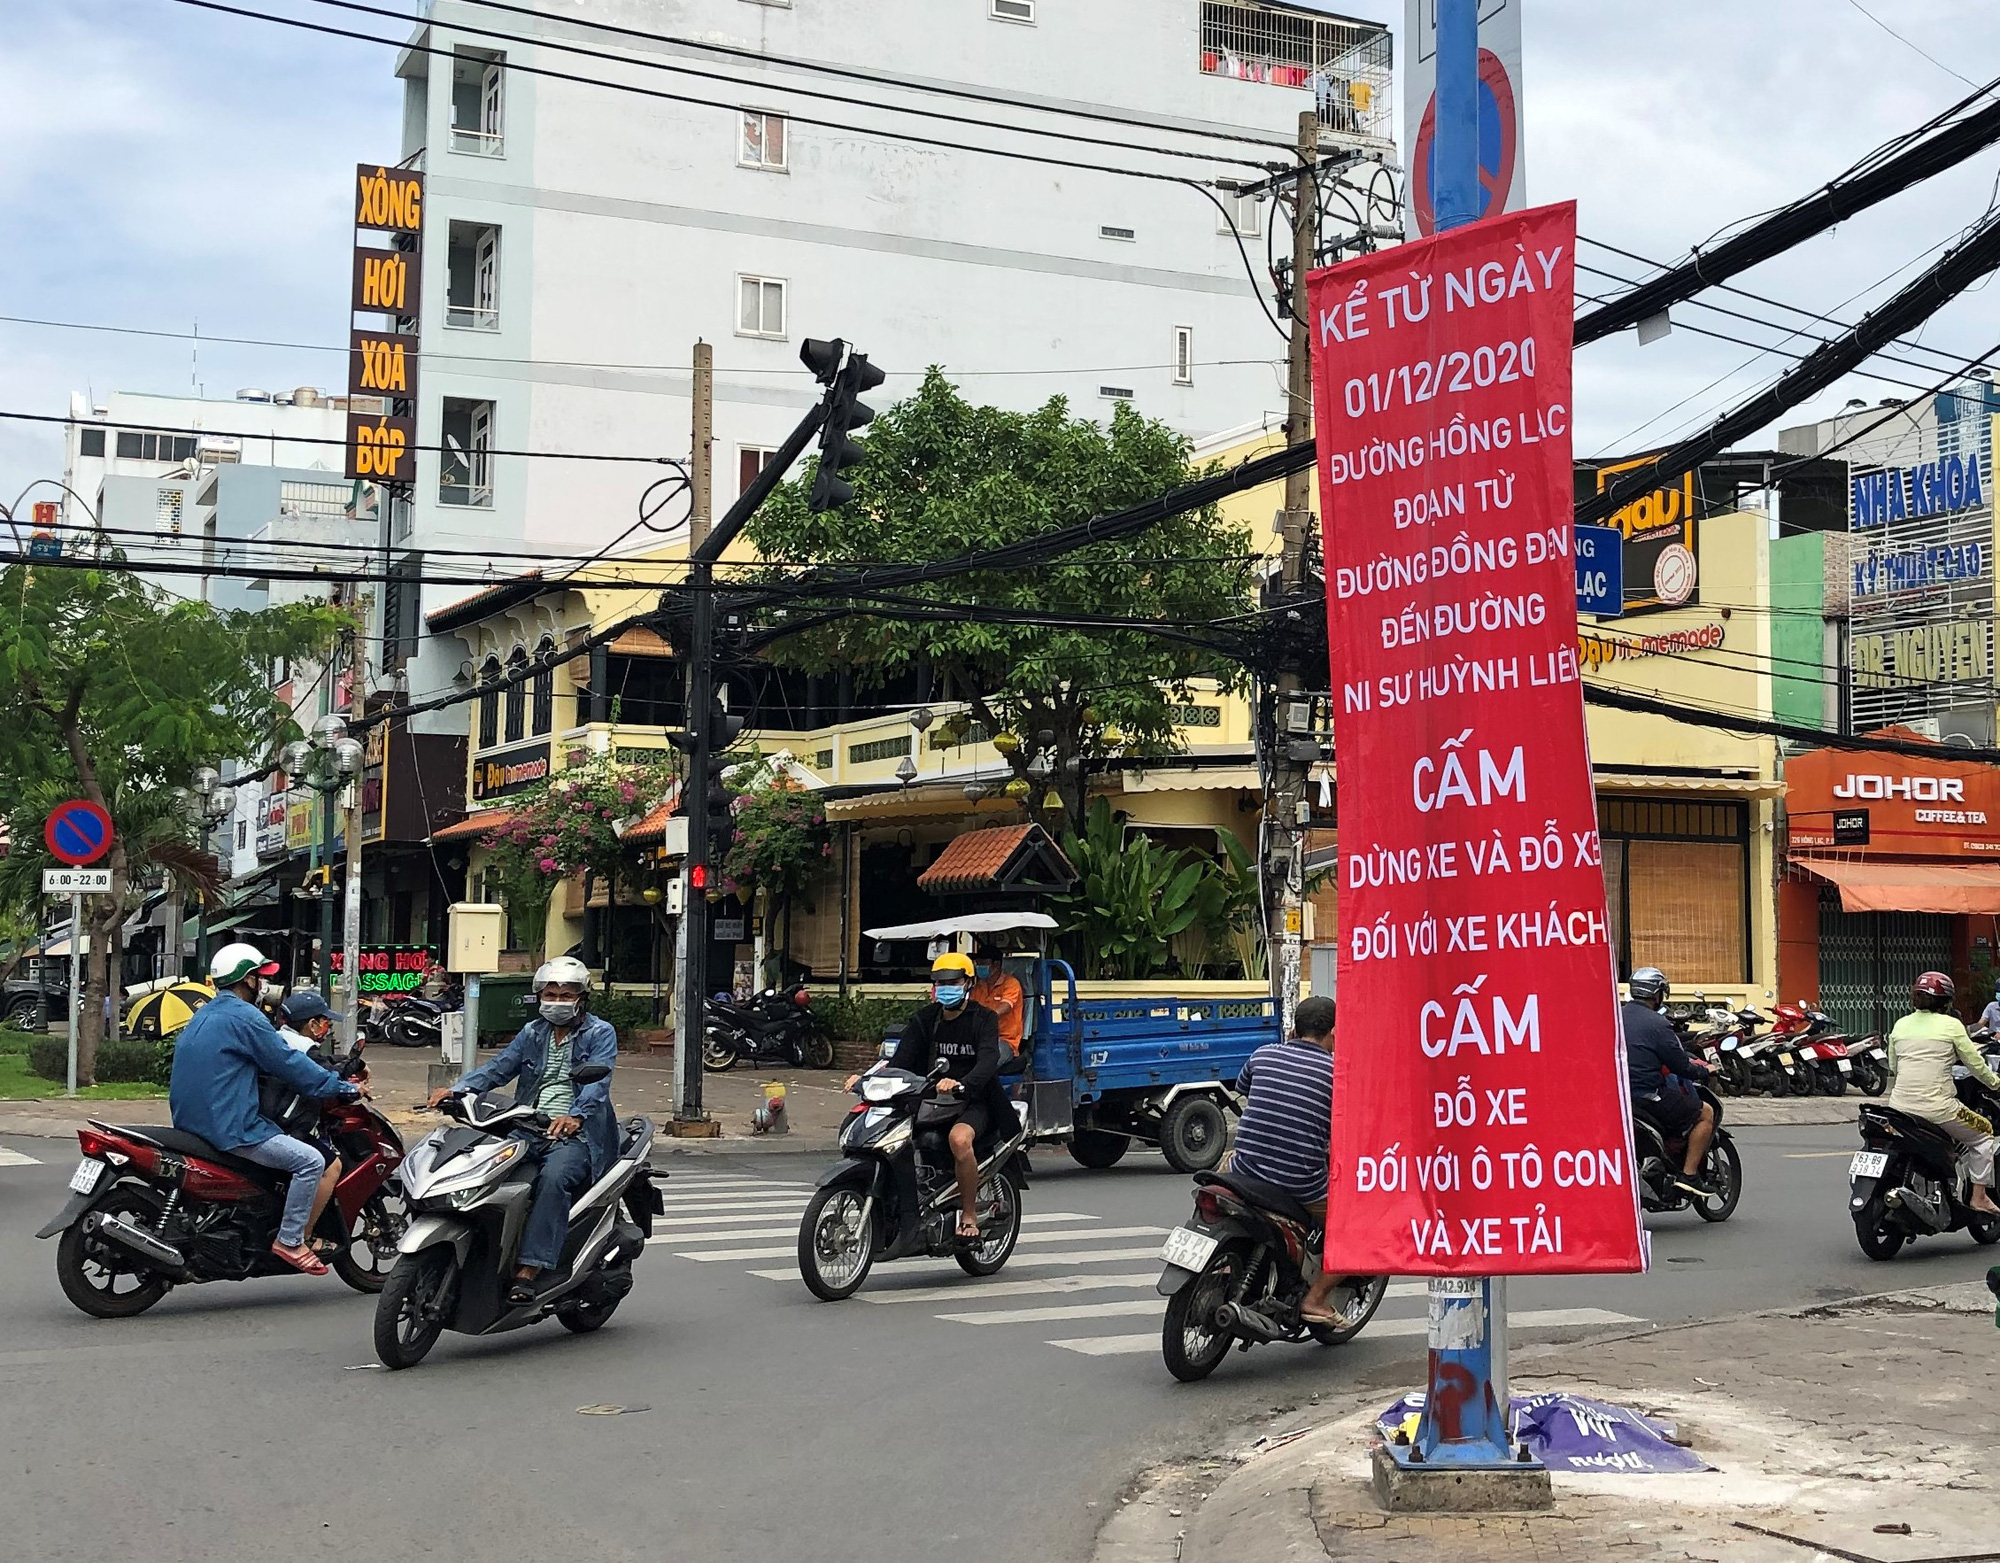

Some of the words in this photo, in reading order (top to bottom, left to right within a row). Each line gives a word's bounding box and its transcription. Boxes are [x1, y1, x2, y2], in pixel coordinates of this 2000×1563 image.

[358, 167, 420, 230] XÔNG
[362, 254, 406, 309] HƠI
[1320, 280, 1369, 347] KỂ
[1378, 271, 1432, 328] TỪ
[1445, 244, 1562, 312] NGÀY
[360, 339, 406, 392] XOA
[1344, 336, 1536, 418] 01/12/2020
[356, 417, 405, 477] BÓP
[1332, 437, 1424, 484] ĐƯỜNG
[1430, 413, 1511, 460] HỒNG
[1394, 484, 1464, 529] ĐOẠN
[1474, 469, 1515, 511] TỪ
[1855, 468, 1908, 528] NHA
[1911, 453, 1983, 517] KHOA
[1337, 553, 1427, 598] ĐƯỜNG
[1432, 531, 1517, 577] ĐỒNG
[1574, 538, 1595, 558] NG
[1943, 542, 1981, 579] CAO
[1574, 571, 1607, 603] LẠC
[1381, 602, 1429, 648] ĐẾN
[1434, 591, 1545, 636] ĐƯỜNG
[1345, 681, 1370, 713] NI
[1379, 670, 1412, 707] SƯ
[1420, 654, 1518, 700] HUỲNH
[1414, 729, 1525, 812] CẤM
[1833, 774, 1966, 802] JOHOR
[1836, 817, 1864, 829] JOHOR
[1350, 844, 1420, 888] DỪNG
[1427, 843, 1457, 879] XE
[1465, 829, 1511, 875] VÀ
[1519, 819, 1563, 871] ĐỖ
[1572, 831, 1600, 868] XE
[1351, 911, 1396, 960] ĐỐI
[1404, 911, 1437, 956] VỚI
[1446, 916, 1487, 952] XE
[1496, 902, 1608, 949] KHÁCH
[330, 952, 389, 970] XNG
[395, 950, 428, 970] HƠ
[330, 973, 422, 991] SSAG
[1421, 975, 1540, 1057] CẤM
[1435, 1075, 1476, 1127] ĐỖ
[1486, 1088, 1527, 1125] XE
[1357, 1142, 1406, 1191] ĐỐI
[1416, 1146, 1459, 1191] VỚI
[1472, 1145, 1492, 1189] Ô
[1501, 1143, 1542, 1189] TÔ
[1554, 1149, 1621, 1187] CON
[1411, 1210, 1452, 1255] VÀ
[1460, 1218, 1502, 1255] XE
[1510, 1203, 1561, 1253] TẢI
